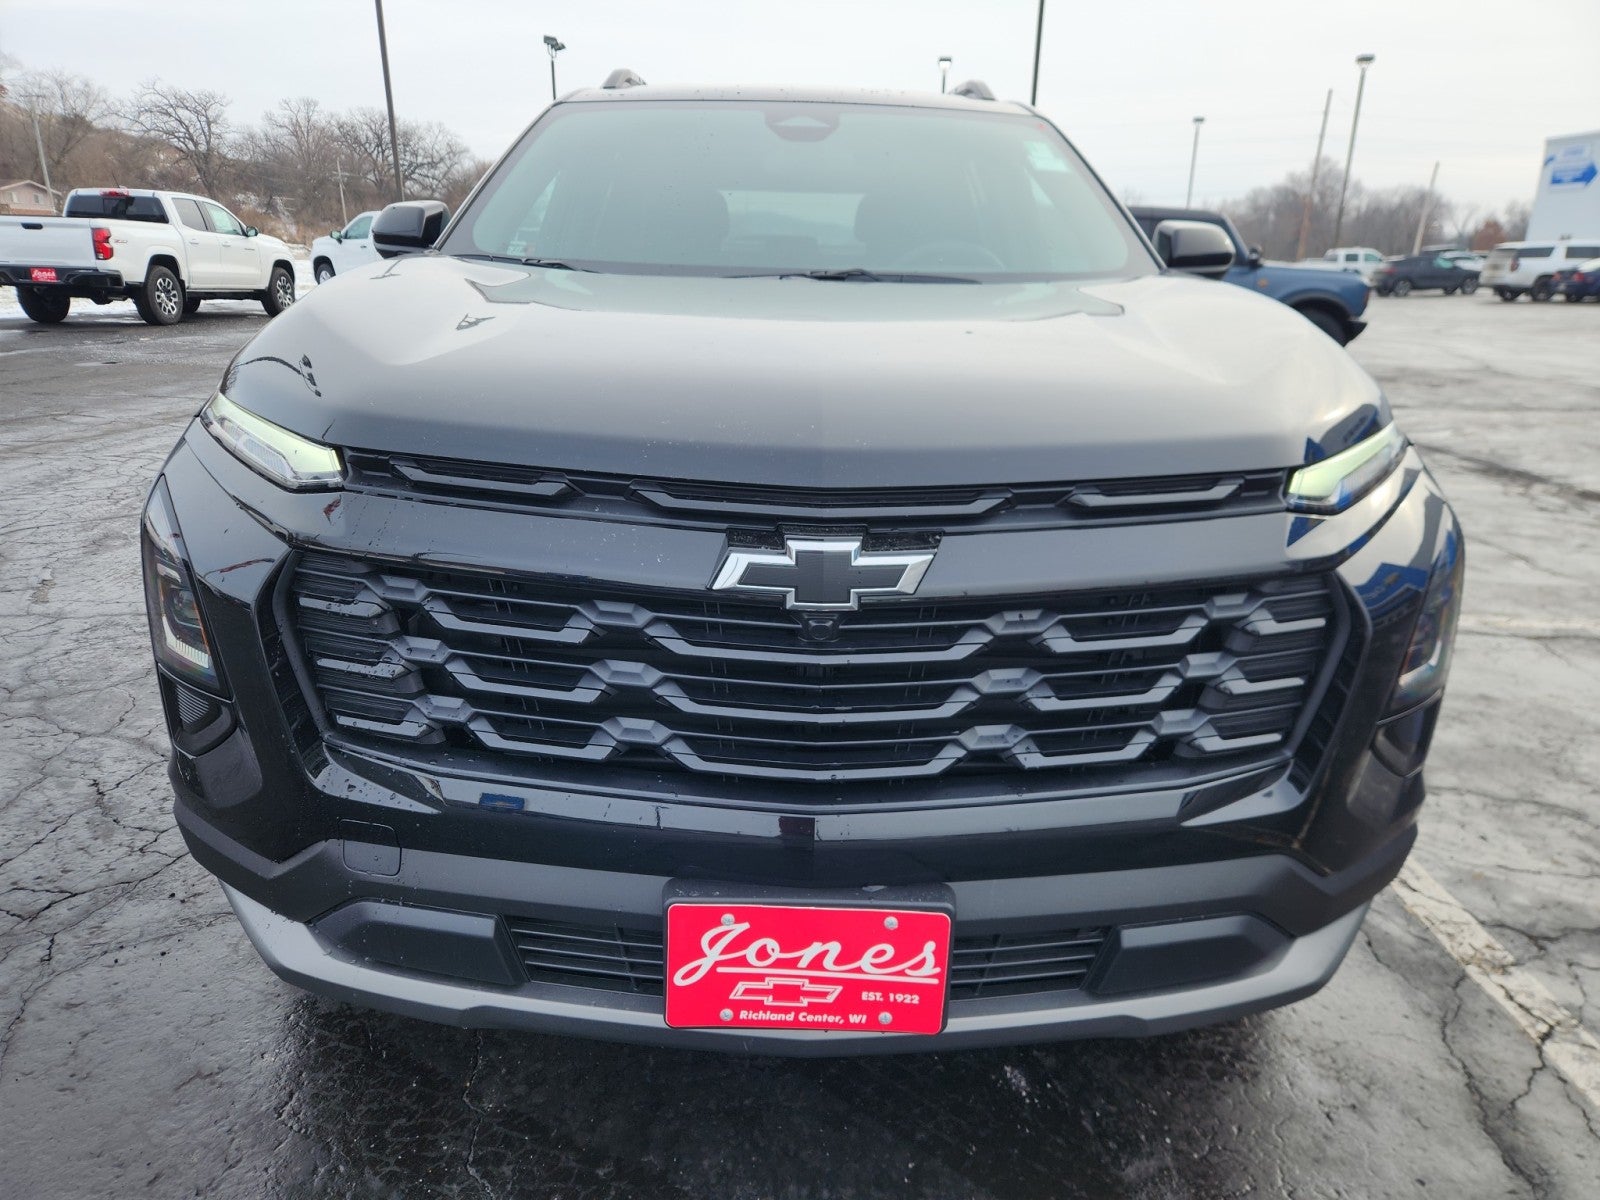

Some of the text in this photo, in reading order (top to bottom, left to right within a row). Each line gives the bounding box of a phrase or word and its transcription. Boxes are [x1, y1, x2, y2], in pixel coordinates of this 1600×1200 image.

[673, 922, 941, 986] Jones
[861, 991, 920, 1004] EST. 1922
[739, 1010, 868, 1024] Richland Center, WI
